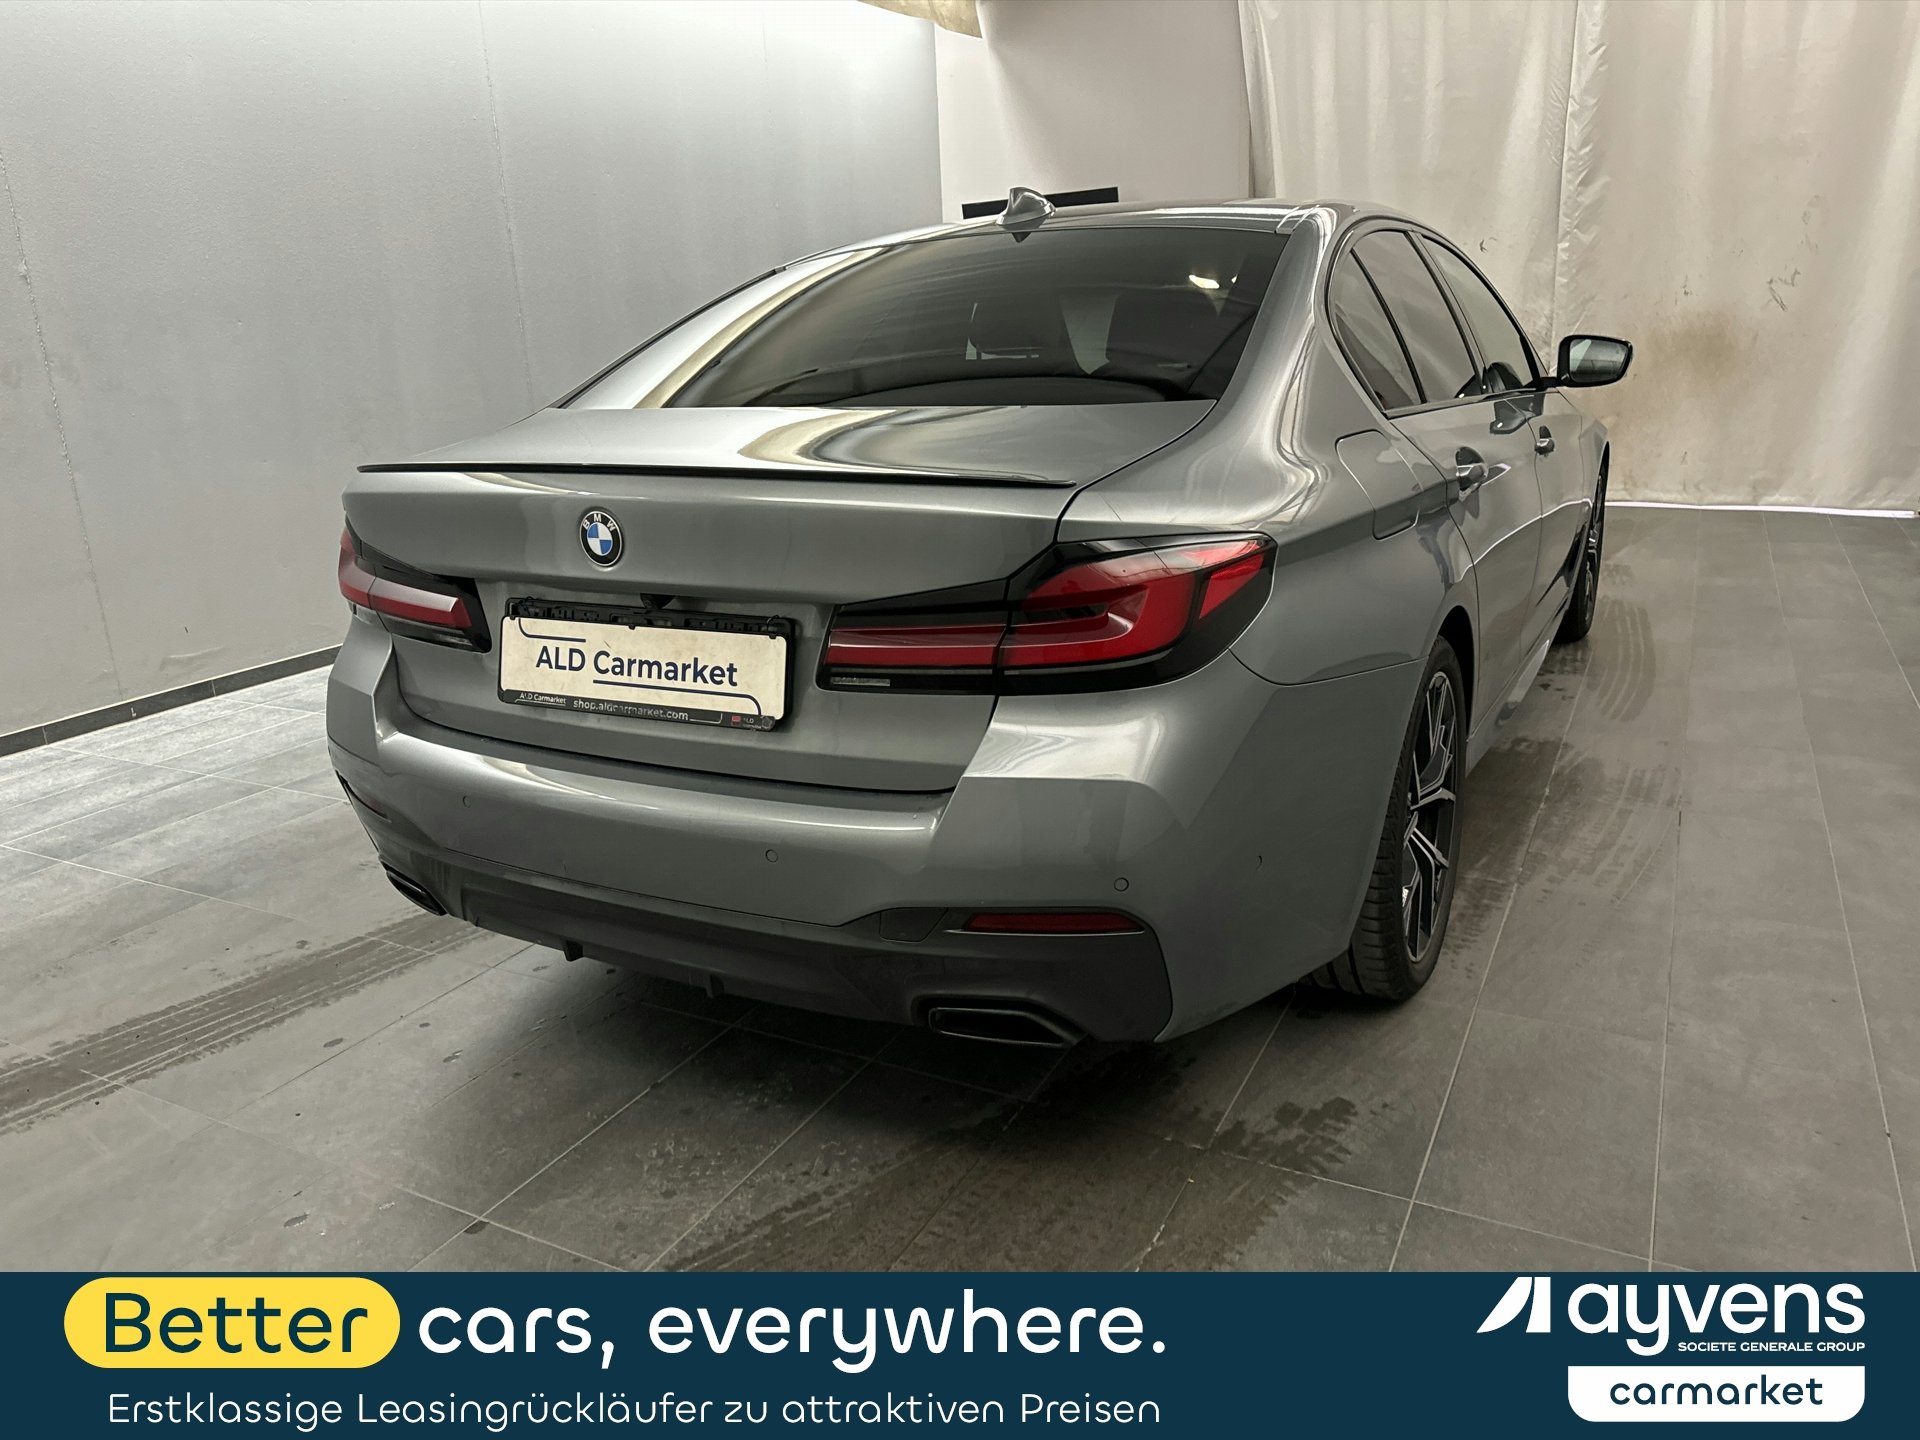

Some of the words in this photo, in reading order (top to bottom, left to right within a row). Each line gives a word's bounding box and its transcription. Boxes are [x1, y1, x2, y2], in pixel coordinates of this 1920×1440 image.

[582, 513, 616, 531] BMW
[536, 645, 586, 671] ALD
[593, 650, 738, 687] Carmarket
[534, 694, 567, 704] Carmarket
